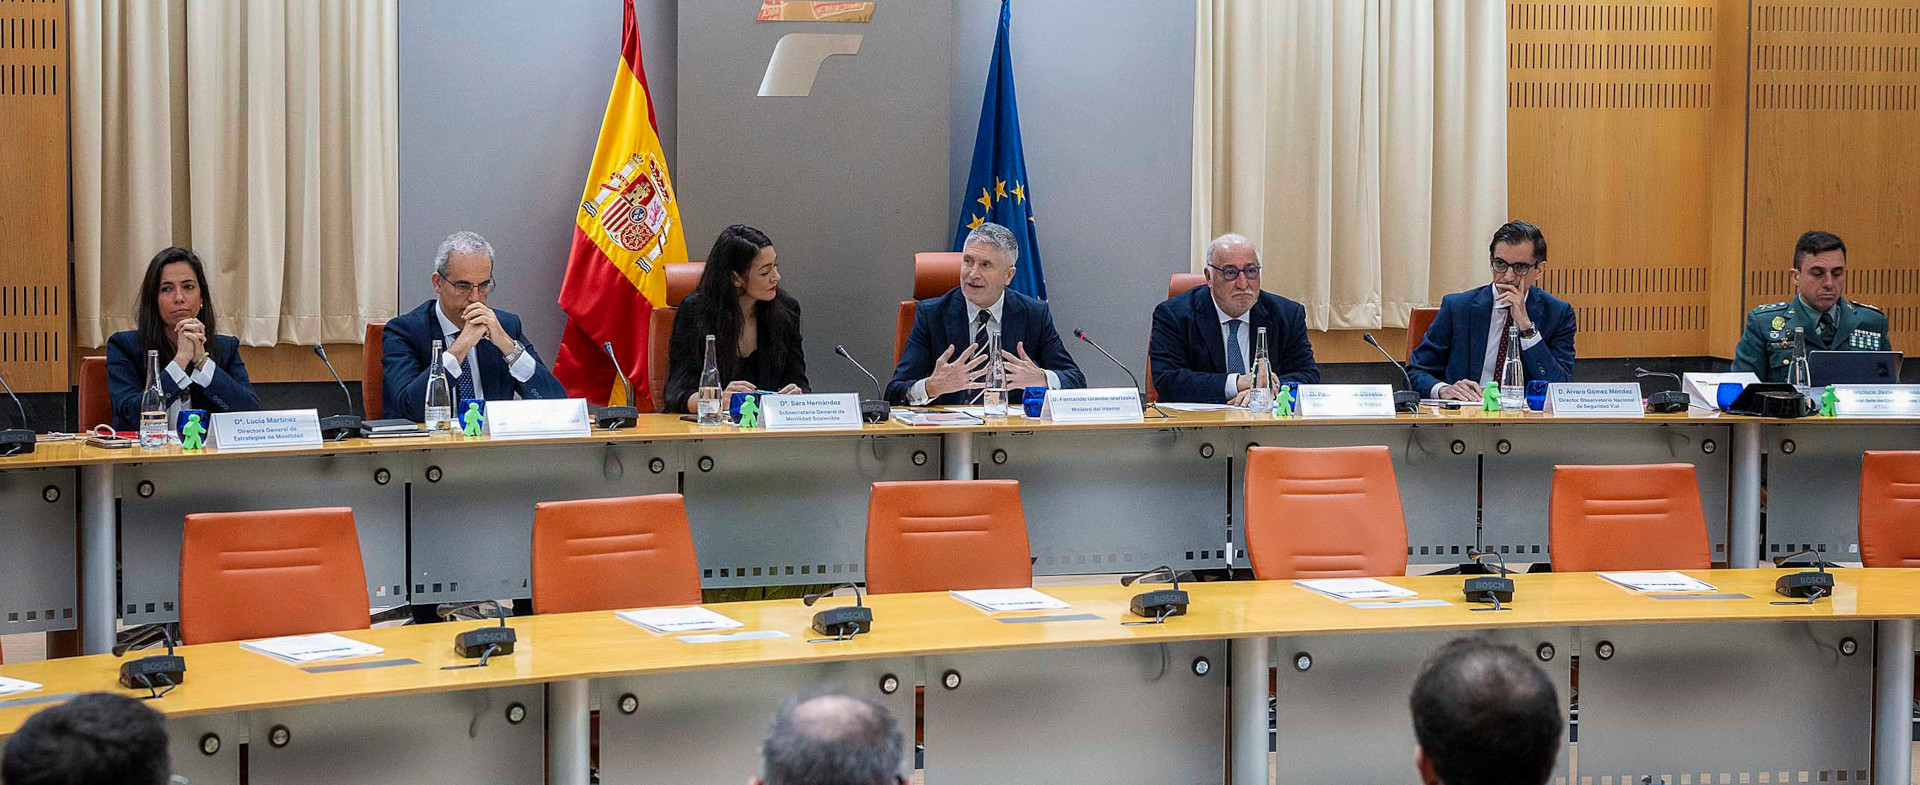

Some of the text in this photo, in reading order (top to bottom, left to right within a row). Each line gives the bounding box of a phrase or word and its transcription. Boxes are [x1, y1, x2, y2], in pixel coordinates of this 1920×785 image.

[1800, 576, 1826, 584] BOSCH
[1475, 581, 1505, 589] BOSCH
[1153, 595, 1180, 604] BOSCH
[836, 610, 864, 620] BOSCH
[476, 632, 507, 641] BOSCH
[142, 660, 176, 672] BOSCH
